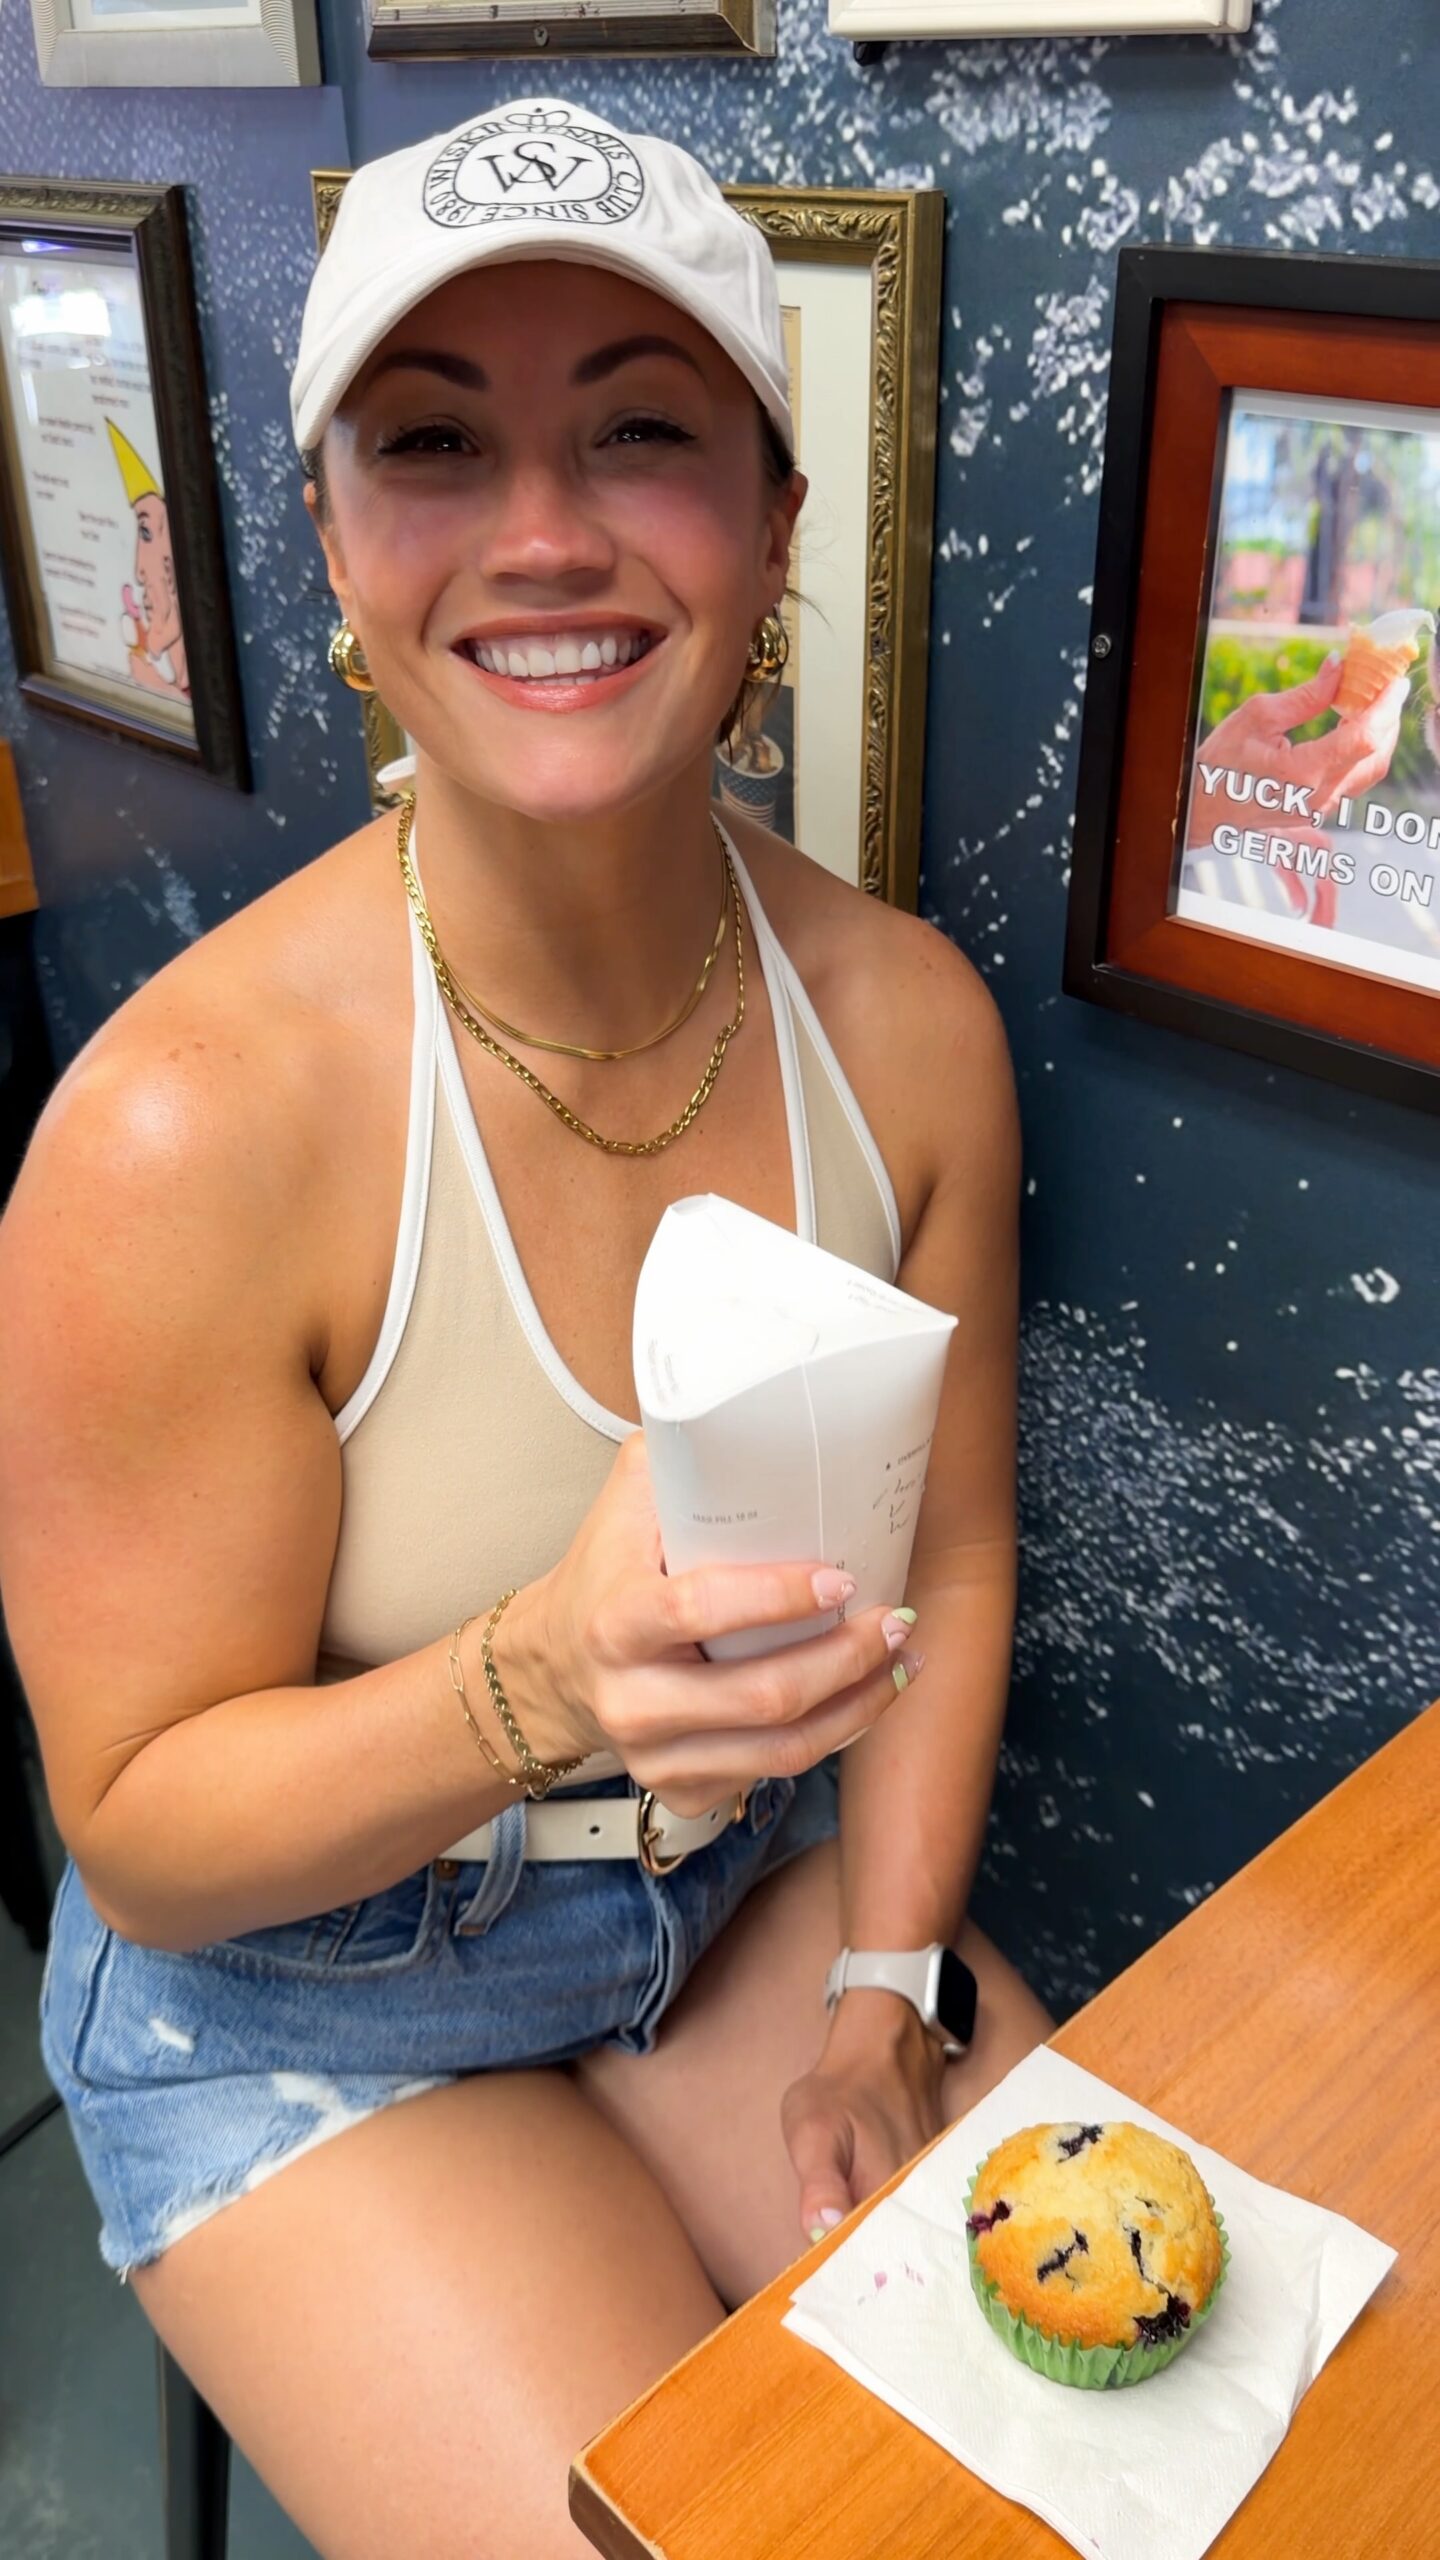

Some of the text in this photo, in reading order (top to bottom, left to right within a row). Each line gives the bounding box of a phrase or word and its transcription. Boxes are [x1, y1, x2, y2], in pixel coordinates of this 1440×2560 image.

[430, 191, 475, 224] 1980
[481, 203, 589, 221] SINCE
[597, 171, 641, 218] CLUB
[1197, 763, 1322, 828] YUCK,
[1337, 796, 1351, 828] I
[1211, 824, 1435, 907] GERMS ON
